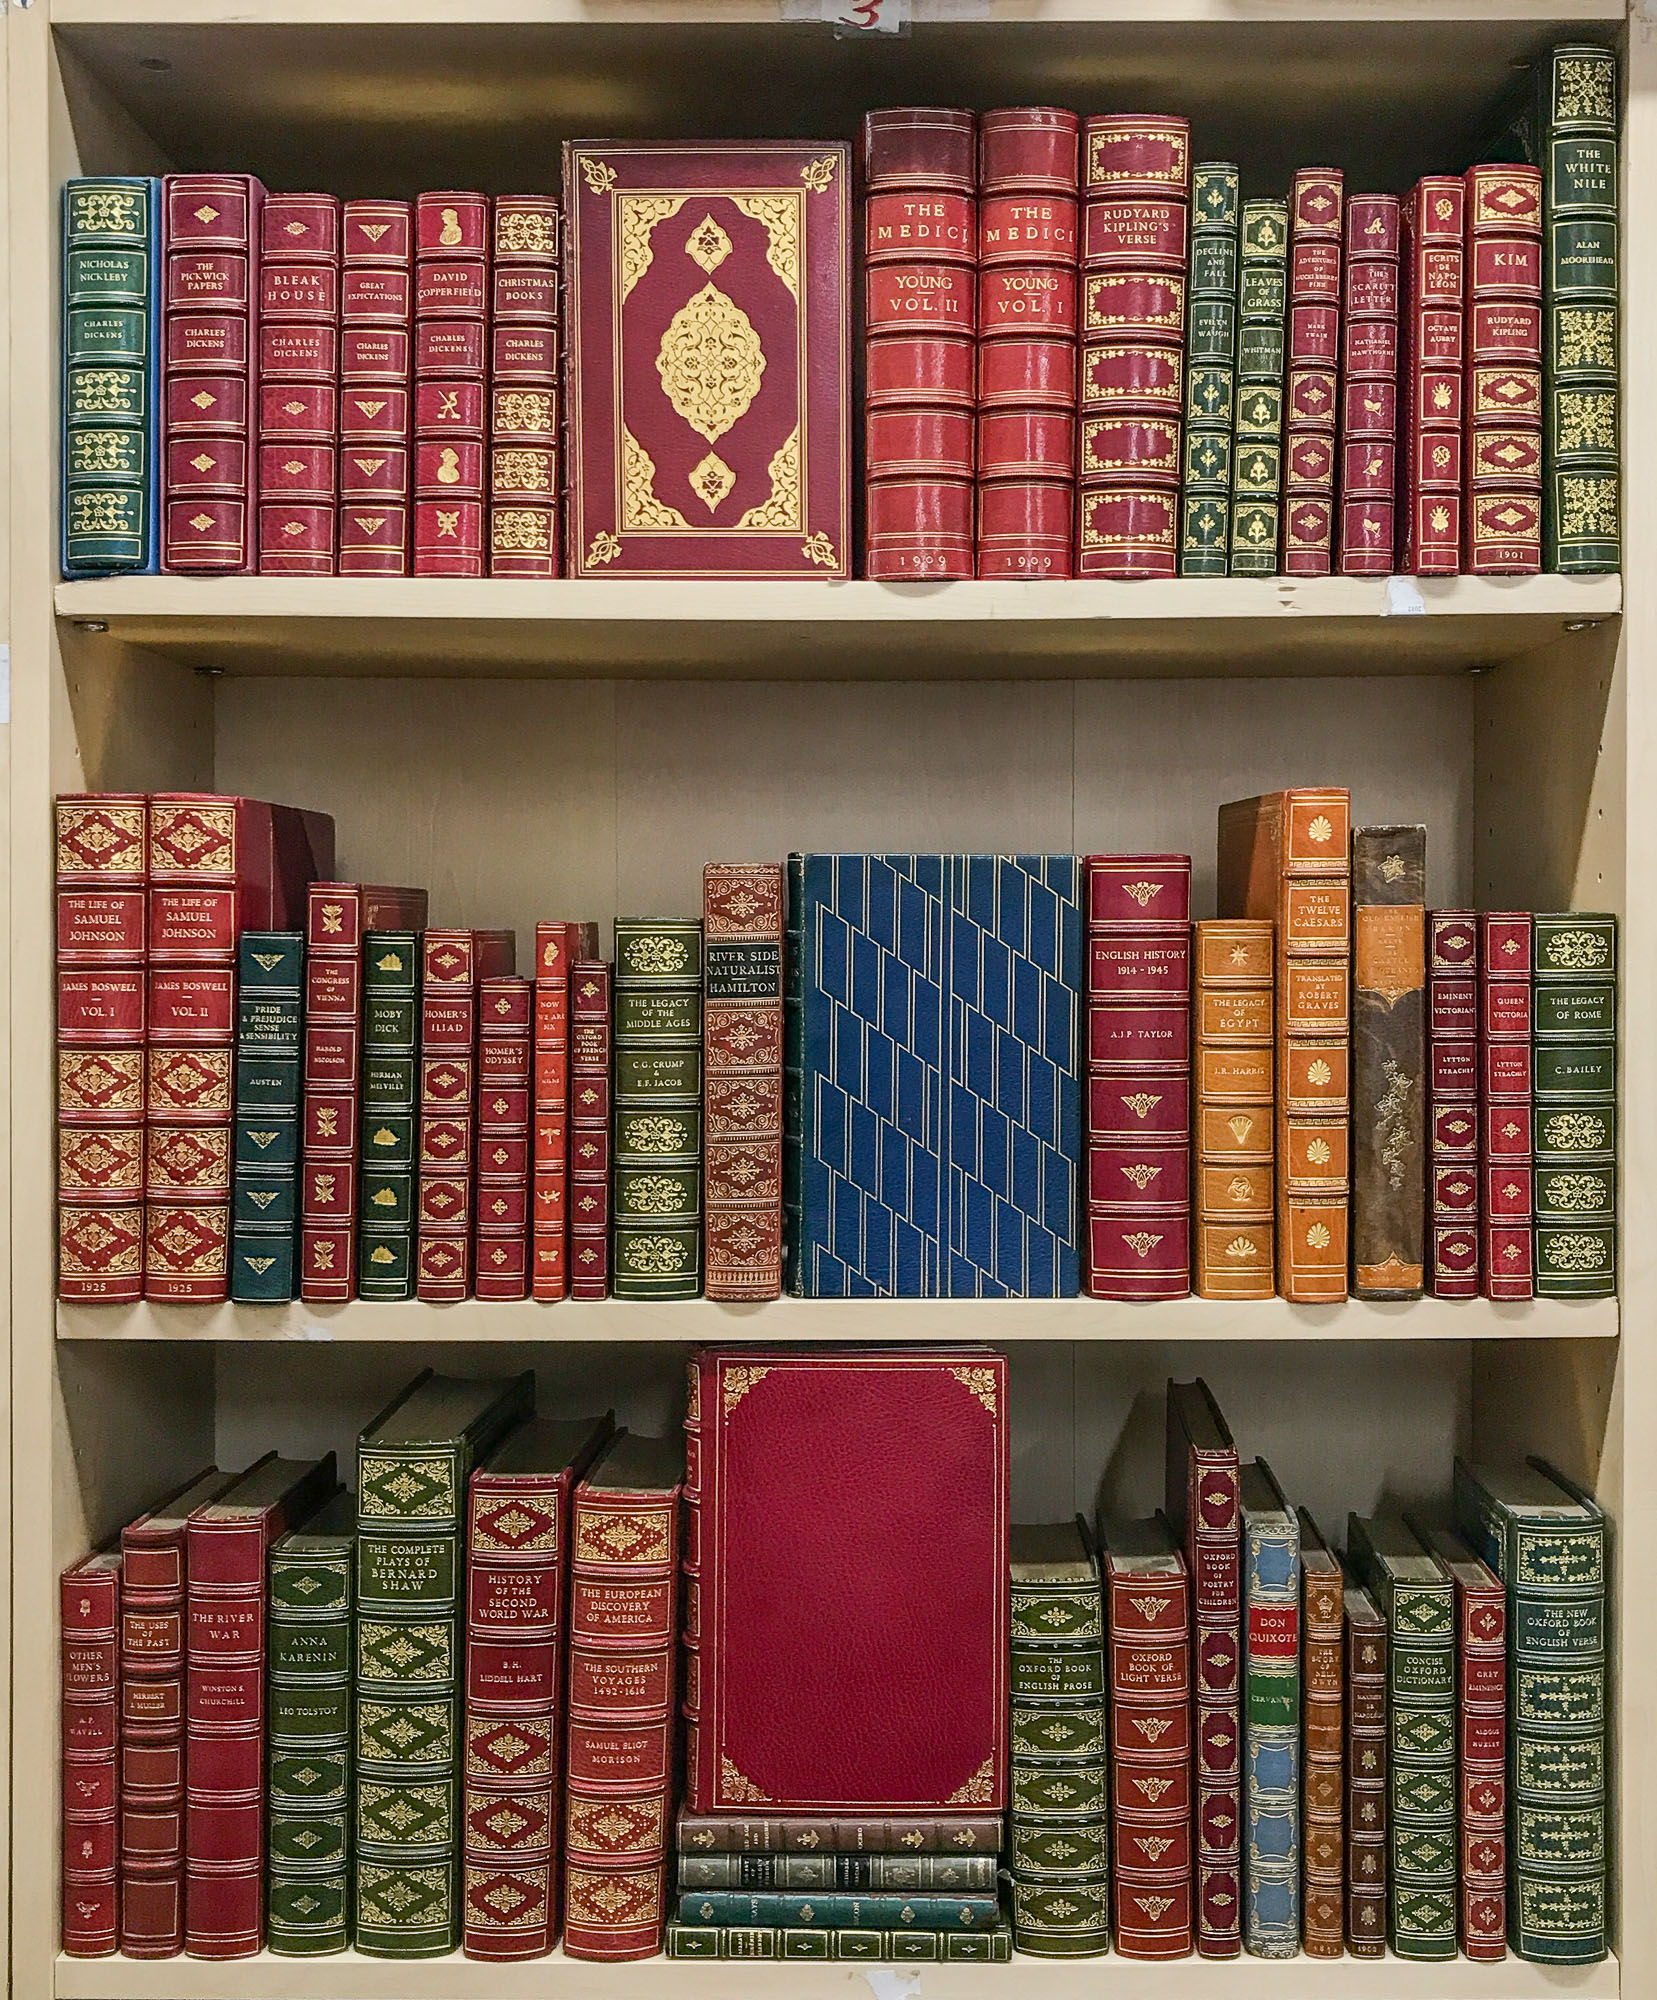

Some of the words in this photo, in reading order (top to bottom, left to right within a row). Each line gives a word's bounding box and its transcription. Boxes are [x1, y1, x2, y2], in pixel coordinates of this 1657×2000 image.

[1577, 150, 1601, 159] THE
[1565, 163, 1612, 174] WHITE
[1574, 179, 1606, 189] NILE
[904, 204, 945, 217] THE
[1011, 207, 1052, 220] THE
[1104, 209, 1170, 221] RUDYARD
[1104, 222, 1170, 233] KIPLING'S
[878, 224, 968, 243] MEDICI
[986, 227, 1073, 243] MEDICI
[1118, 234, 1157, 244] VERSE
[80, 261, 129, 269] NICHOLAS
[1494, 254, 1528, 267] KIM
[80, 273, 128, 282] NICKLEBY
[274, 276, 320, 286] BLEAK
[434, 273, 468, 282] DAVID
[188, 282, 223, 291] PAPERS
[499, 279, 554, 288] CHRISTMAS
[896, 276, 953, 289] YOUNG
[1003, 278, 1059, 291] YOUNG
[1246, 278, 1283, 287] LEAVES
[268, 291, 326, 301] HOUSE
[506, 292, 543, 300] BOOKS
[1354, 296, 1392, 304] LETTER
[890, 299, 938, 312] VOL.
[946, 300, 958, 312] II
[1248, 299, 1282, 308] GRASS
[185, 329, 226, 337] CHARLES
[1493, 328, 1528, 336] KIPLING
[186, 340, 225, 348] DICKENS
[272, 339, 320, 347] CHARLES
[506, 340, 544, 348] CHARLES
[274, 349, 319, 358] DICKENS
[505, 353, 544, 361] DICKENS
[1499, 551, 1524, 560] 1901
[901, 556, 946, 567] 1909
[1006, 557, 1052, 567] 1909
[68, 901, 86, 909] THE
[89, 901, 108, 909] LIFE
[162, 898, 179, 906] THE
[182, 899, 201, 907] LIFE
[204, 899, 218, 907] OF
[1298, 906, 1341, 914] TWELVE
[75, 915, 122, 924] SAMUEL
[166, 913, 213, 922] SAMUEL
[1294, 919, 1343, 927] CAESARS
[70, 931, 125, 941] JOHNSON
[162, 929, 217, 939] JOHNSON
[1096, 951, 1140, 961] ENGLISH
[1144, 950, 1186, 960] HISTORY
[63, 983, 88, 992] JAMES
[91, 983, 137, 992] BOSWELL
[711, 983, 775, 992] HAMILTON
[1299, 992, 1339, 1000] ROBERT
[652, 999, 689, 1007] LEGACY
[1234, 999, 1265, 1007] LEGACY
[1298, 1002, 1339, 1010] GRAVES
[1550, 998, 1568, 1006] THE
[1571, 997, 1604, 1005] LEGACY
[255, 1006, 281, 1014] PRIDE
[374, 1010, 403, 1018] MOBY
[425, 1010, 467, 1019] HOMER'S
[1234, 1009, 1245, 1017] OF
[1493, 1011, 1528, 1019] VICTORIA
[1557, 1012, 1570, 1020] OF
[1574, 1011, 1602, 1019] ROME
[254, 1024, 280, 1032] SENSE
[432, 1024, 463, 1032] ILIAD
[627, 1020, 661, 1028] MIDDLE
[666, 1019, 690, 1027] AGES
[1220, 1019, 1259, 1028] EGYPT
[376, 1025, 399, 1033] DICK
[81, 1283, 106, 1291] 1925
[168, 1284, 192, 1292] 1925
[368, 1545, 390, 1554] THE
[392, 1545, 445, 1554] COMPLETE
[377, 1558, 410, 1566] PLAYS
[415, 1558, 430, 1567] OF
[372, 1569, 438, 1579] BERNARD
[489, 1576, 543, 1584] HISTORY
[383, 1581, 424, 1591] SHAW
[581, 1588, 601, 1598] THE
[605, 1589, 662, 1599] EUROPEAN
[489, 1599, 537, 1607] SECOND
[591, 1602, 650, 1611] DISCOVERY
[193, 1613, 215, 1623] THE
[218, 1613, 254, 1623] RIVER
[479, 1609, 518, 1619] WORLD
[523, 1609, 549, 1618] WAR
[586, 1613, 600, 1622] OF
[604, 1615, 653, 1623] AMERICA
[1544, 1610, 1564, 1618] THE
[1566, 1609, 1588, 1618] NEW
[1261, 1619, 1286, 1627] DON
[1527, 1618, 1569, 1627] OXFORD
[1573, 1618, 1597, 1627] BOOK
[209, 1630, 240, 1639] WAR
[1250, 1633, 1297, 1642] QUIXOTE
[1558, 1629, 1571, 1637] OF
[291, 1638, 328, 1646] ANNA
[1526, 1637, 1568, 1647] ENGLISH
[1573, 1636, 1598, 1646] VERSE
[70, 1652, 103, 1660] OTHER
[281, 1652, 337, 1662] KARENIN
[1132, 1654, 1172, 1662] OXFORD
[1407, 1657, 1443, 1666] CONCISE
[584, 1663, 602, 1672] THE
[606, 1663, 658, 1673] SOUTHERN
[1019, 1665, 1061, 1673] OXFORD
[1065, 1664, 1092, 1673] BOOK
[1129, 1663, 1157, 1672] BOOK
[1162, 1663, 1174, 1672] OF
[1404, 1666, 1446, 1675] OXFORD
[592, 1676, 646, 1684] VOYAGES
[1121, 1673, 1149, 1682] LIGHT
[1155, 1672, 1182, 1682] VERSE
[1019, 1682, 1059, 1690] ENGLISH
[1064, 1682, 1093, 1690] PROSE
[592, 1755, 640, 1763] MORISON
